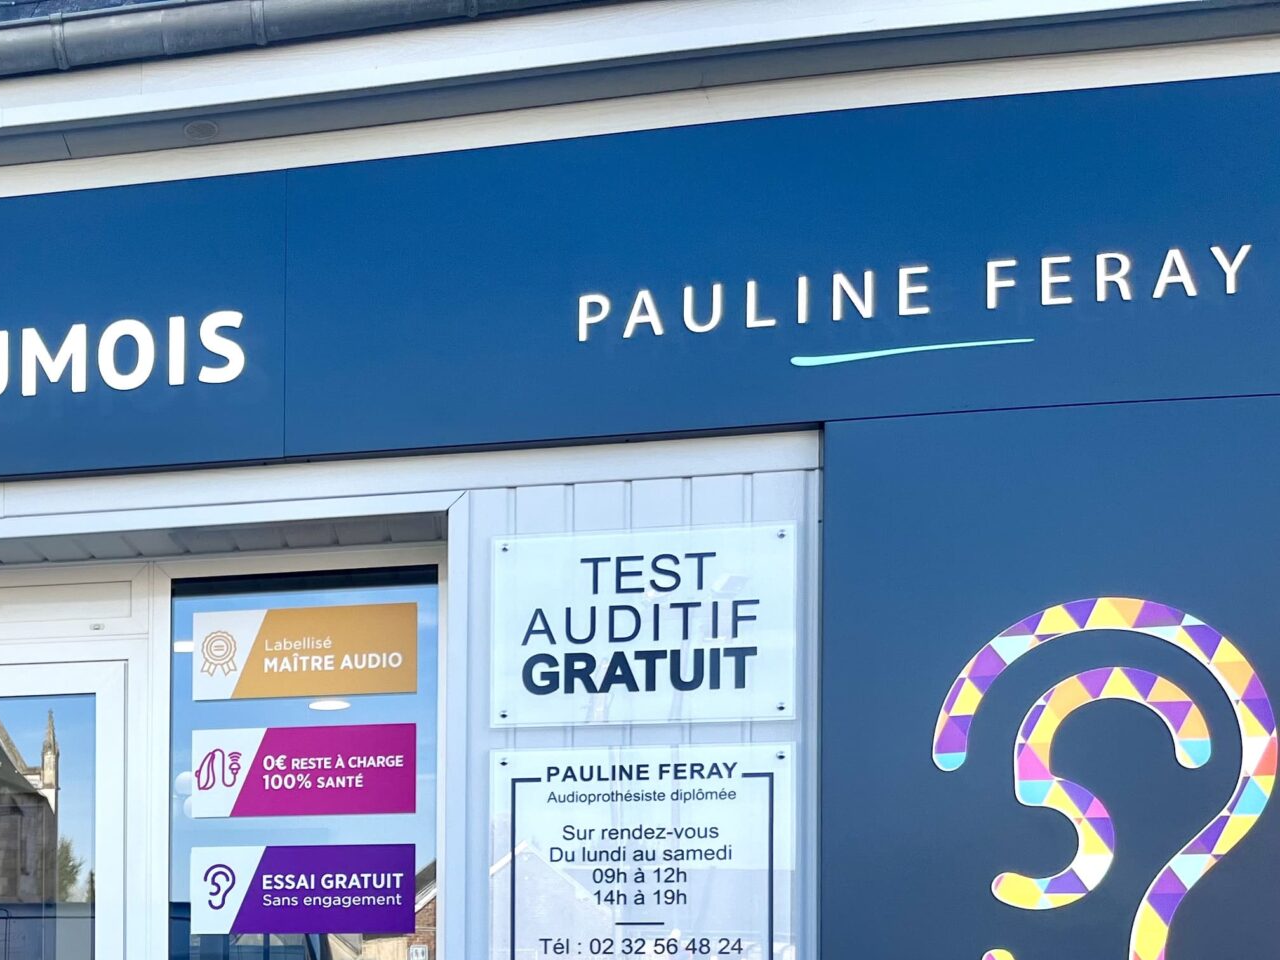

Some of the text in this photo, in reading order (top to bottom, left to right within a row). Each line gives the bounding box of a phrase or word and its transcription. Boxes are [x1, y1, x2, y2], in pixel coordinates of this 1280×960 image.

[578, 244, 1252, 342] PAULINE FERAY
[580, 552, 716, 595] TEST
[521, 599, 760, 646] AUDITIF
[265, 636, 332, 652] Labellisé
[263, 652, 402, 673] MAÎTRE AUDIO
[522, 646, 757, 695] GRATUIT
[263, 753, 404, 771] 0€ RESTE À CHARGE
[546, 762, 738, 783] PAULINE FERAY
[263, 773, 364, 790] 100% SANTÉ
[547, 788, 737, 805] Audioprothésiste diplômée
[562, 825, 719, 841] Sur rendez-vous
[549, 845, 732, 863] Du lundi au samedi
[262, 873, 403, 890] ESSAI GRATUIT
[592, 868, 687, 884] 09h à 12h
[262, 893, 402, 909] Sans engagement
[593, 890, 687, 905] 14h à 19h
[589, 938, 615, 955] 02
[621, 938, 646, 955] 32
[653, 938, 678, 955] 56
[685, 938, 711, 955] 48
[718, 938, 743, 955] 24
